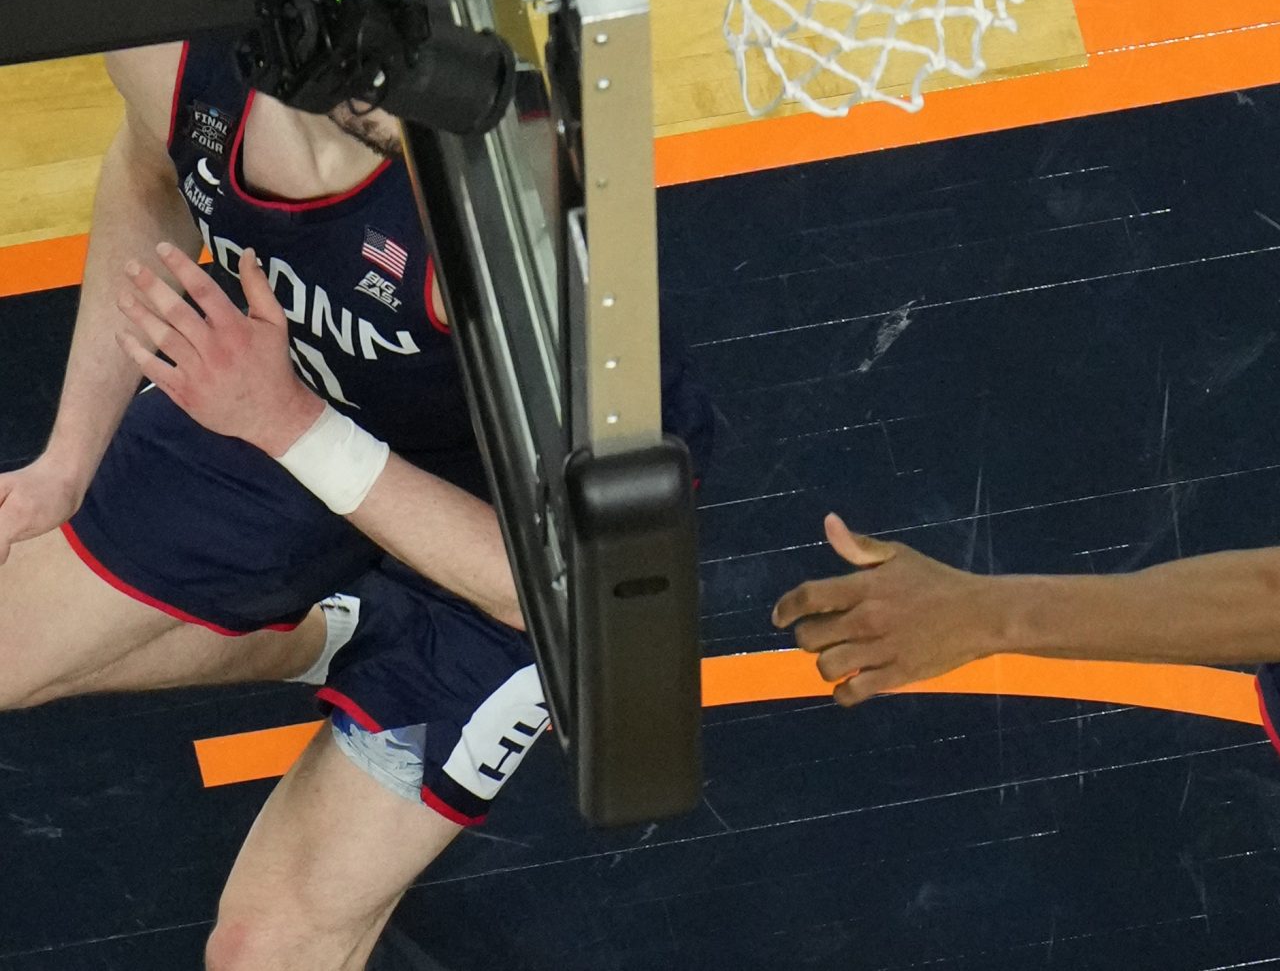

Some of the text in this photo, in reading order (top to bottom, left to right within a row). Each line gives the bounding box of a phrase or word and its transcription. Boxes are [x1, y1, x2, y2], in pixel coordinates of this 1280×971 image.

[194, 111, 228, 136] FINAL
[191, 130, 224, 155] FOUR
[185, 186, 214, 215] ANGE
[358, 278, 402, 308] EAST
[364, 270, 397, 294] BIG
